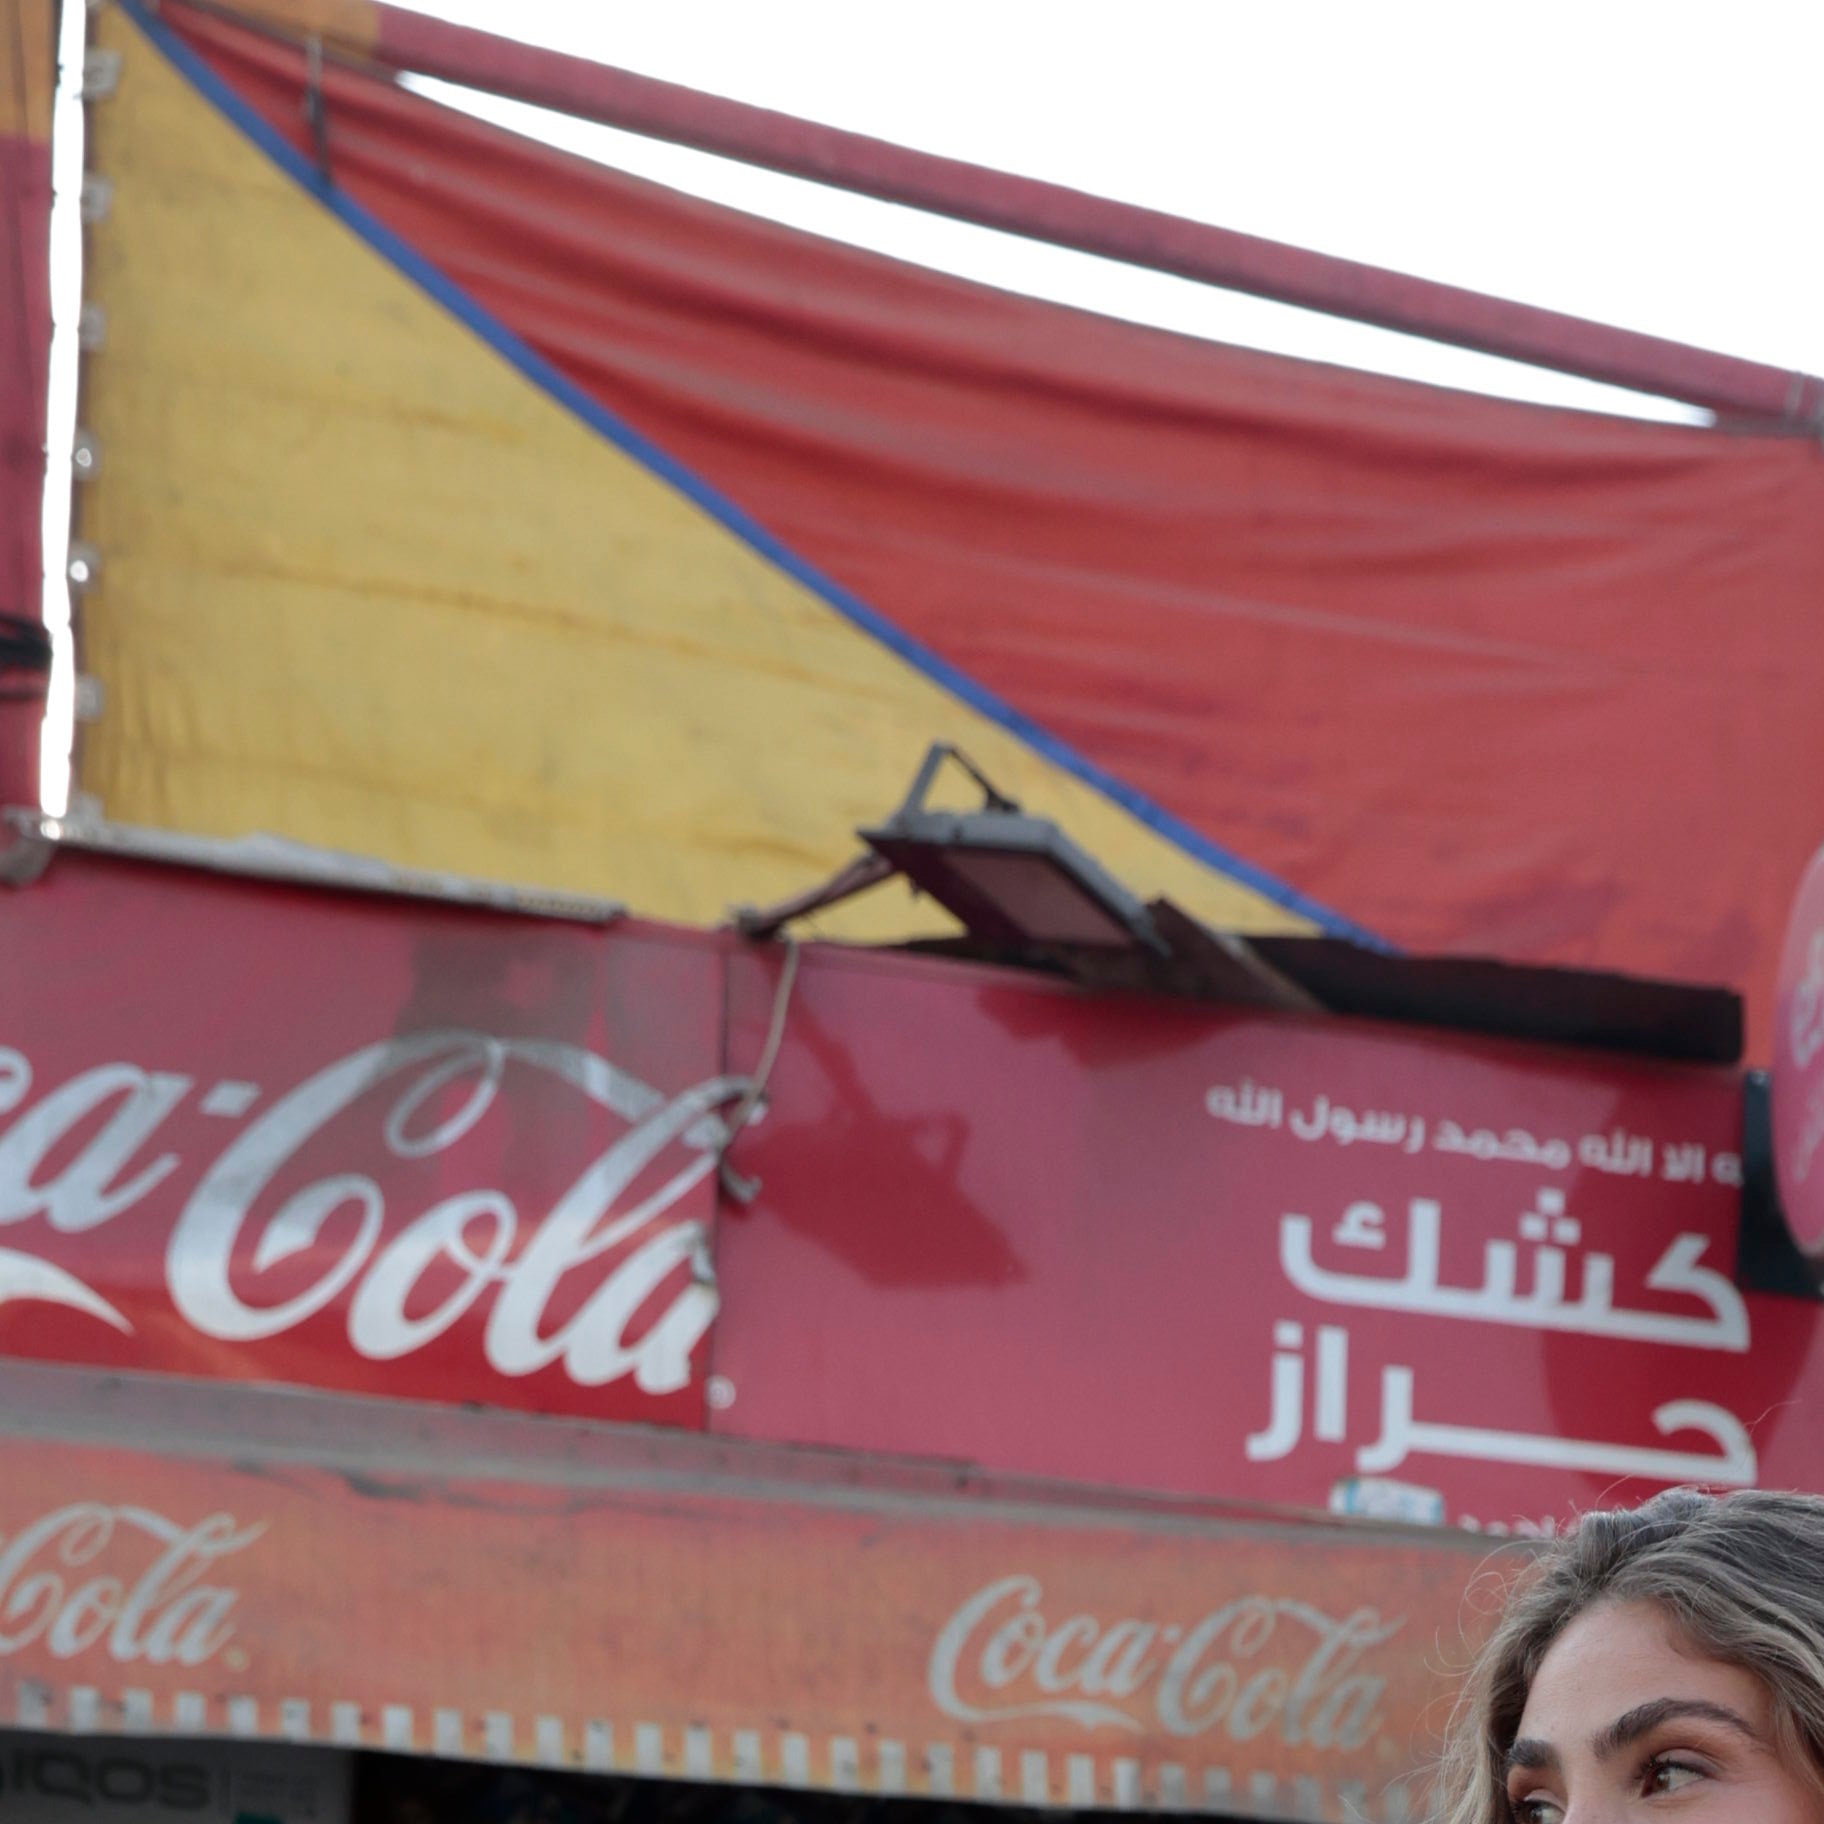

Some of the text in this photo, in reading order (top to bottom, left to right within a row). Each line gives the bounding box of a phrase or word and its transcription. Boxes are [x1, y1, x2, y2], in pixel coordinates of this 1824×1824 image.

[1204, 1077, 1283, 1122] الله
[1290, 1096, 1424, 1153] رسول
[1433, 1118, 1572, 1169] محمد
[1578, 1128, 1651, 1177] الله
[1281, 1189, 1751, 1352] كشك
[929, 1574, 1406, 1754] Coca-Cola
[14, 1748, 210, 1811] IQOS
